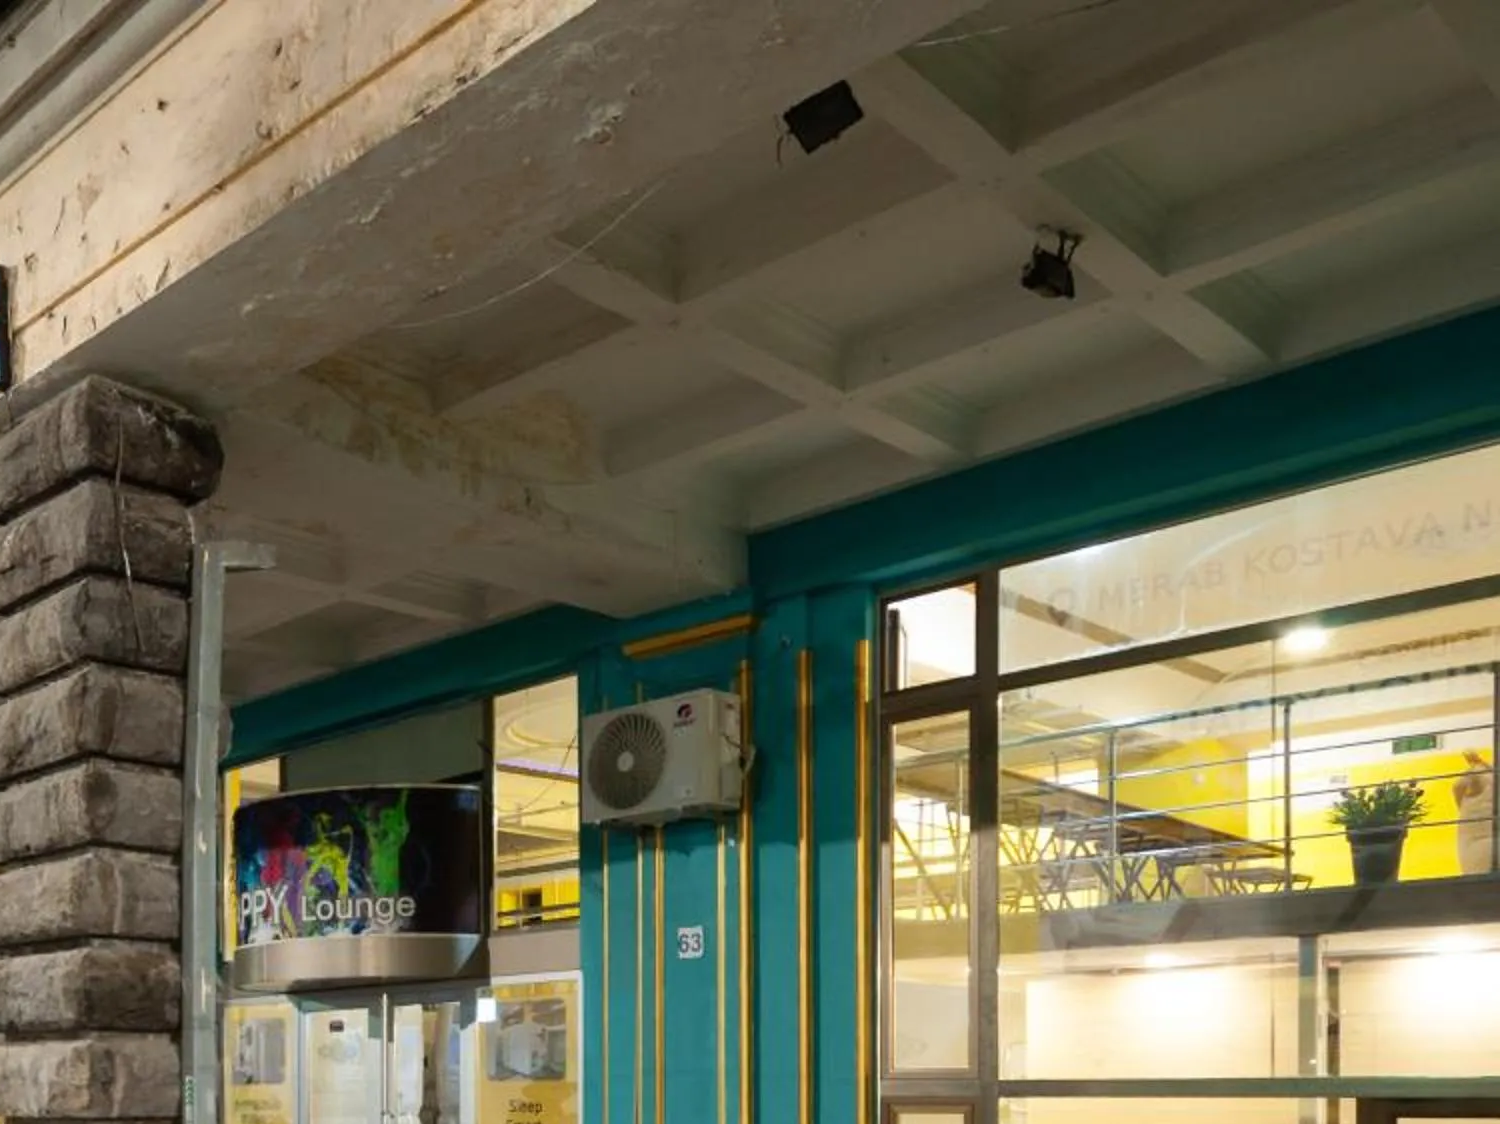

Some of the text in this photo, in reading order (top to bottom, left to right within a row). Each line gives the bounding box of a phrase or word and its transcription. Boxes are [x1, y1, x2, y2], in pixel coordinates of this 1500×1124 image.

[1098, 558, 1226, 612] MERAB
[1244, 511, 1446, 582] KOSTAVA
[302, 894, 416, 925] Lounge
[679, 932, 701, 953] 63
[508, 1098, 543, 1116] Sleep
